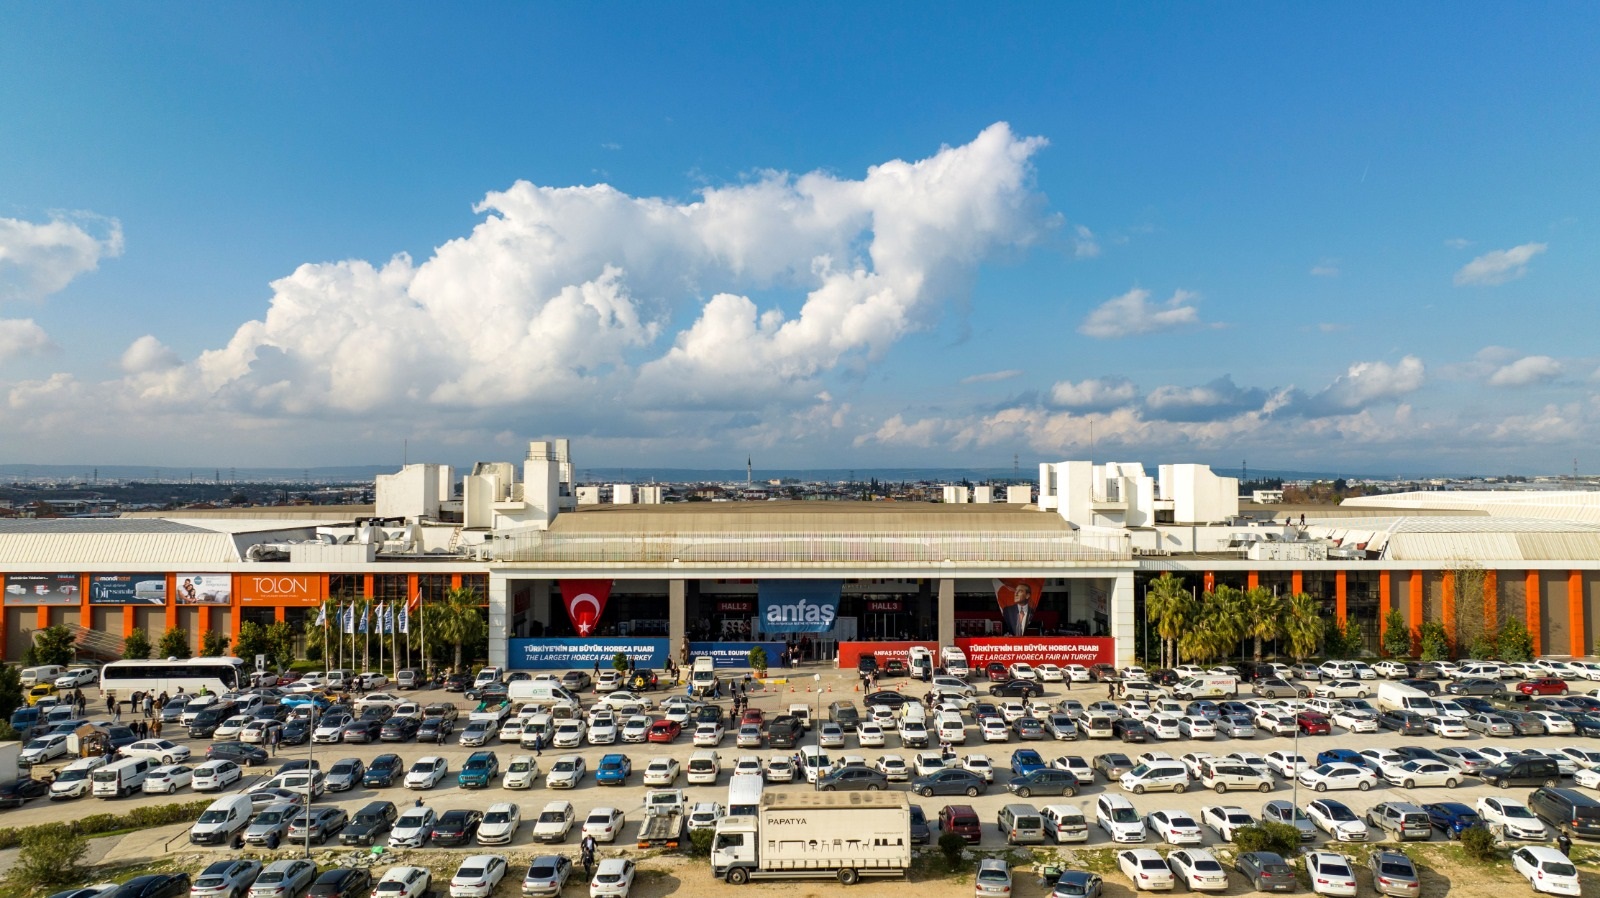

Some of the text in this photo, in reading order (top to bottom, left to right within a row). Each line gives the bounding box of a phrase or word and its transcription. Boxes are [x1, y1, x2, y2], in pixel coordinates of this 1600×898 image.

[252, 577, 307, 593] TOLON
[767, 598, 835, 625] anfaş
[579, 644, 603, 652] BÜYÜK
[969, 644, 1012, 652] TÜRKİYE'NİN
[1024, 644, 1048, 652] BÜYÜK
[1070, 653, 1098, 661] TURKEY
